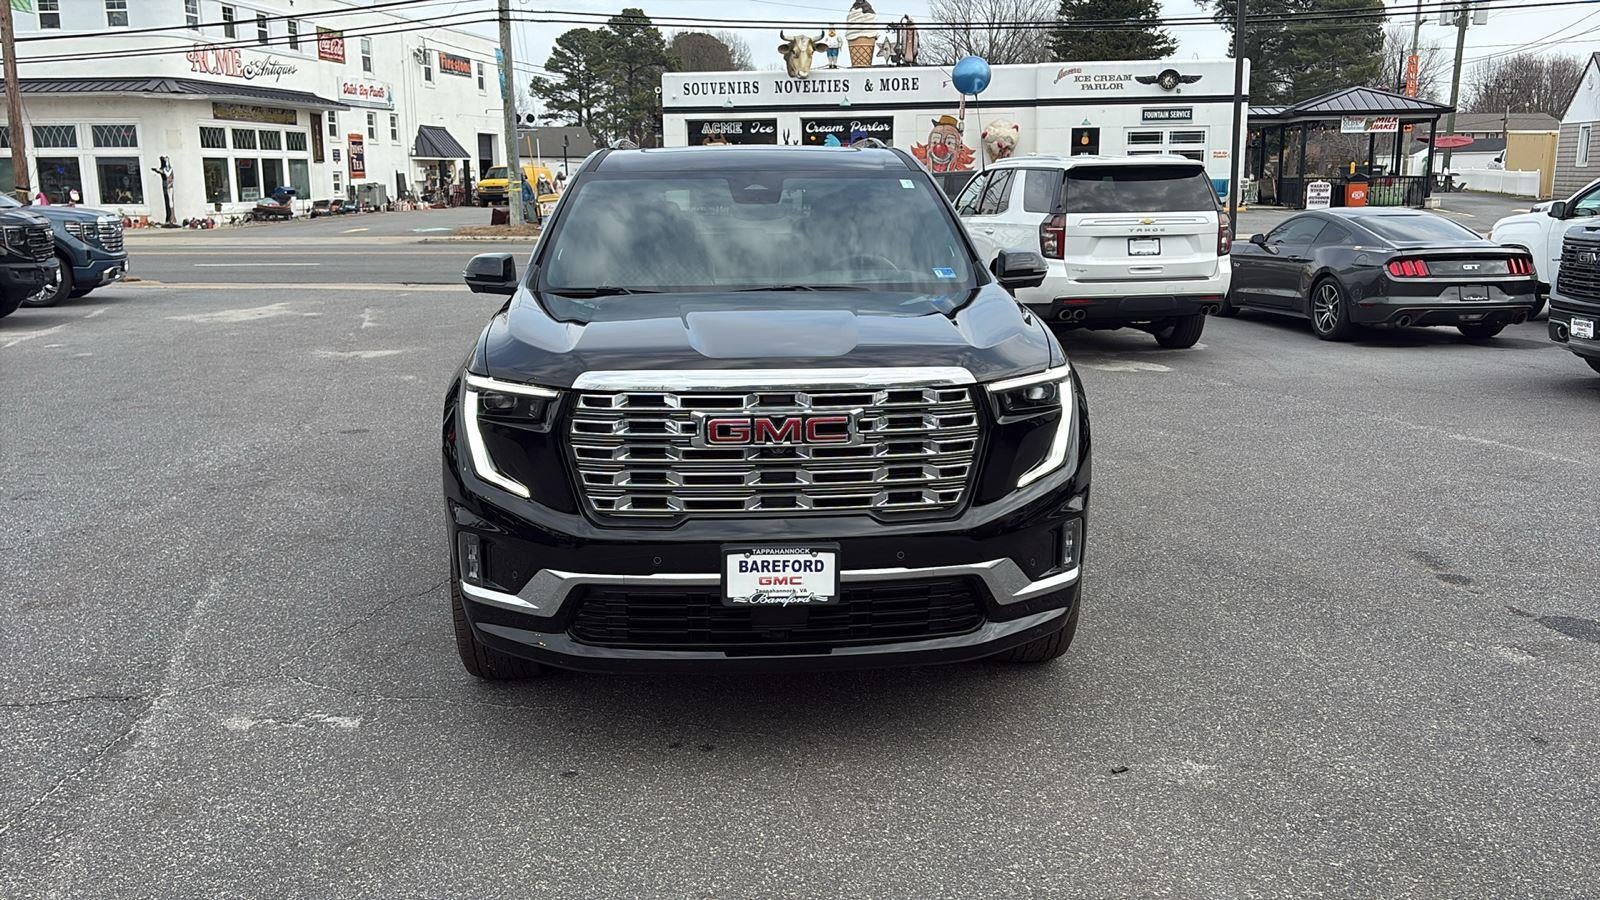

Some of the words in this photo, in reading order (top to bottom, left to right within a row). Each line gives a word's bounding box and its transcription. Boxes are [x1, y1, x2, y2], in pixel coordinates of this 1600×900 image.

[186, 43, 243, 77] ACME
[243, 55, 298, 83] Antiques
[1074, 75, 1091, 83] ICE
[1094, 74, 1132, 82] CREAM
[343, 82, 357, 95] Dutch
[359, 84, 368, 99] Boy
[369, 85, 385, 98] Paints
[683, 80, 760, 95] SOUVENIRS
[774, 79, 850, 94] NOVELTIES
[864, 78, 873, 92] &
[879, 77, 920, 91] MORE
[1144, 110, 1169, 119] FOUNTAIN
[1170, 109, 1191, 118] SERVICE
[701, 121, 743, 134] ACME
[750, 121, 775, 134] Ice
[805, 121, 845, 134] Cream
[849, 120, 891, 133] Parlor
[708, 417, 849, 444] GMC
[739, 559, 825, 573] BAREFORD
[758, 576, 803, 585] GMC
[749, 592, 815, 607] Bareford
